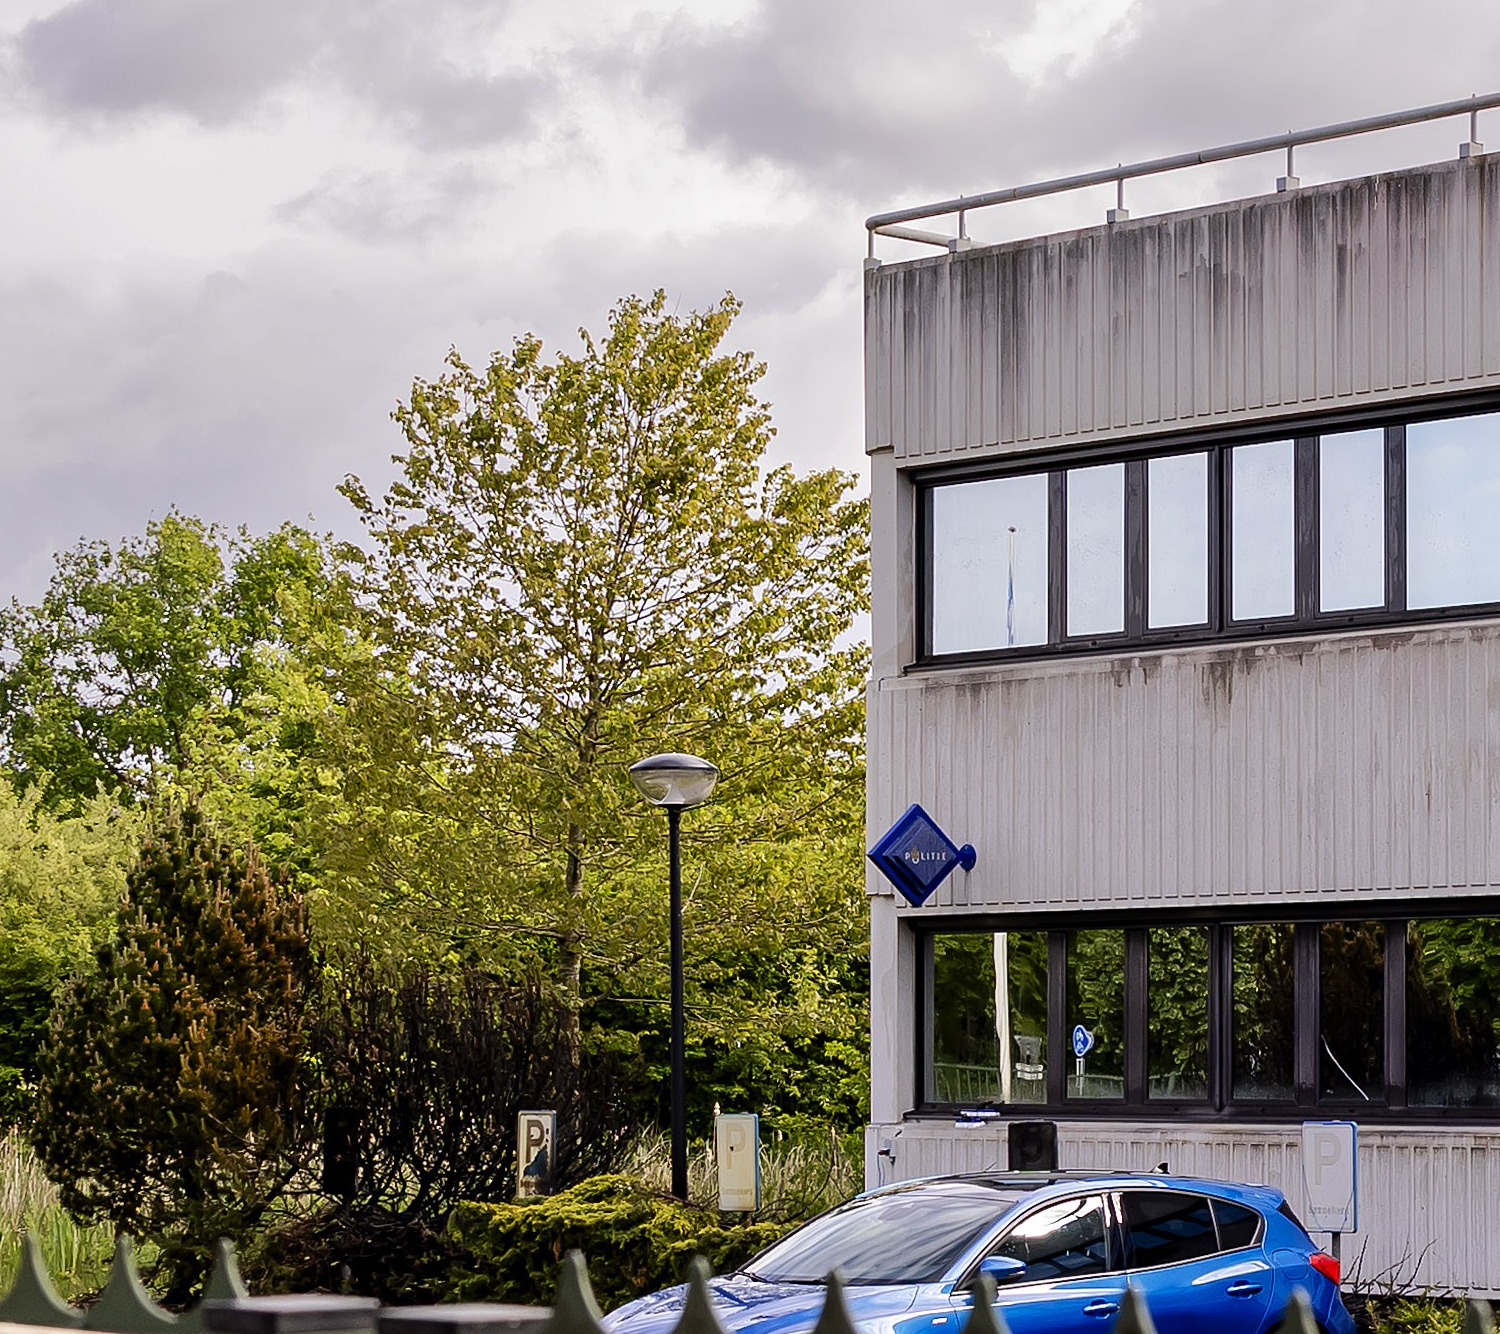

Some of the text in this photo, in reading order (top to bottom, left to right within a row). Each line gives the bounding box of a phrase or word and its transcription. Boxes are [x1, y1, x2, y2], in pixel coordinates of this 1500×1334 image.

[904, 850, 947, 864] POLITIE
[526, 1119, 545, 1164] P
[725, 1122, 746, 1169] P
[1314, 1132, 1341, 1185] P
